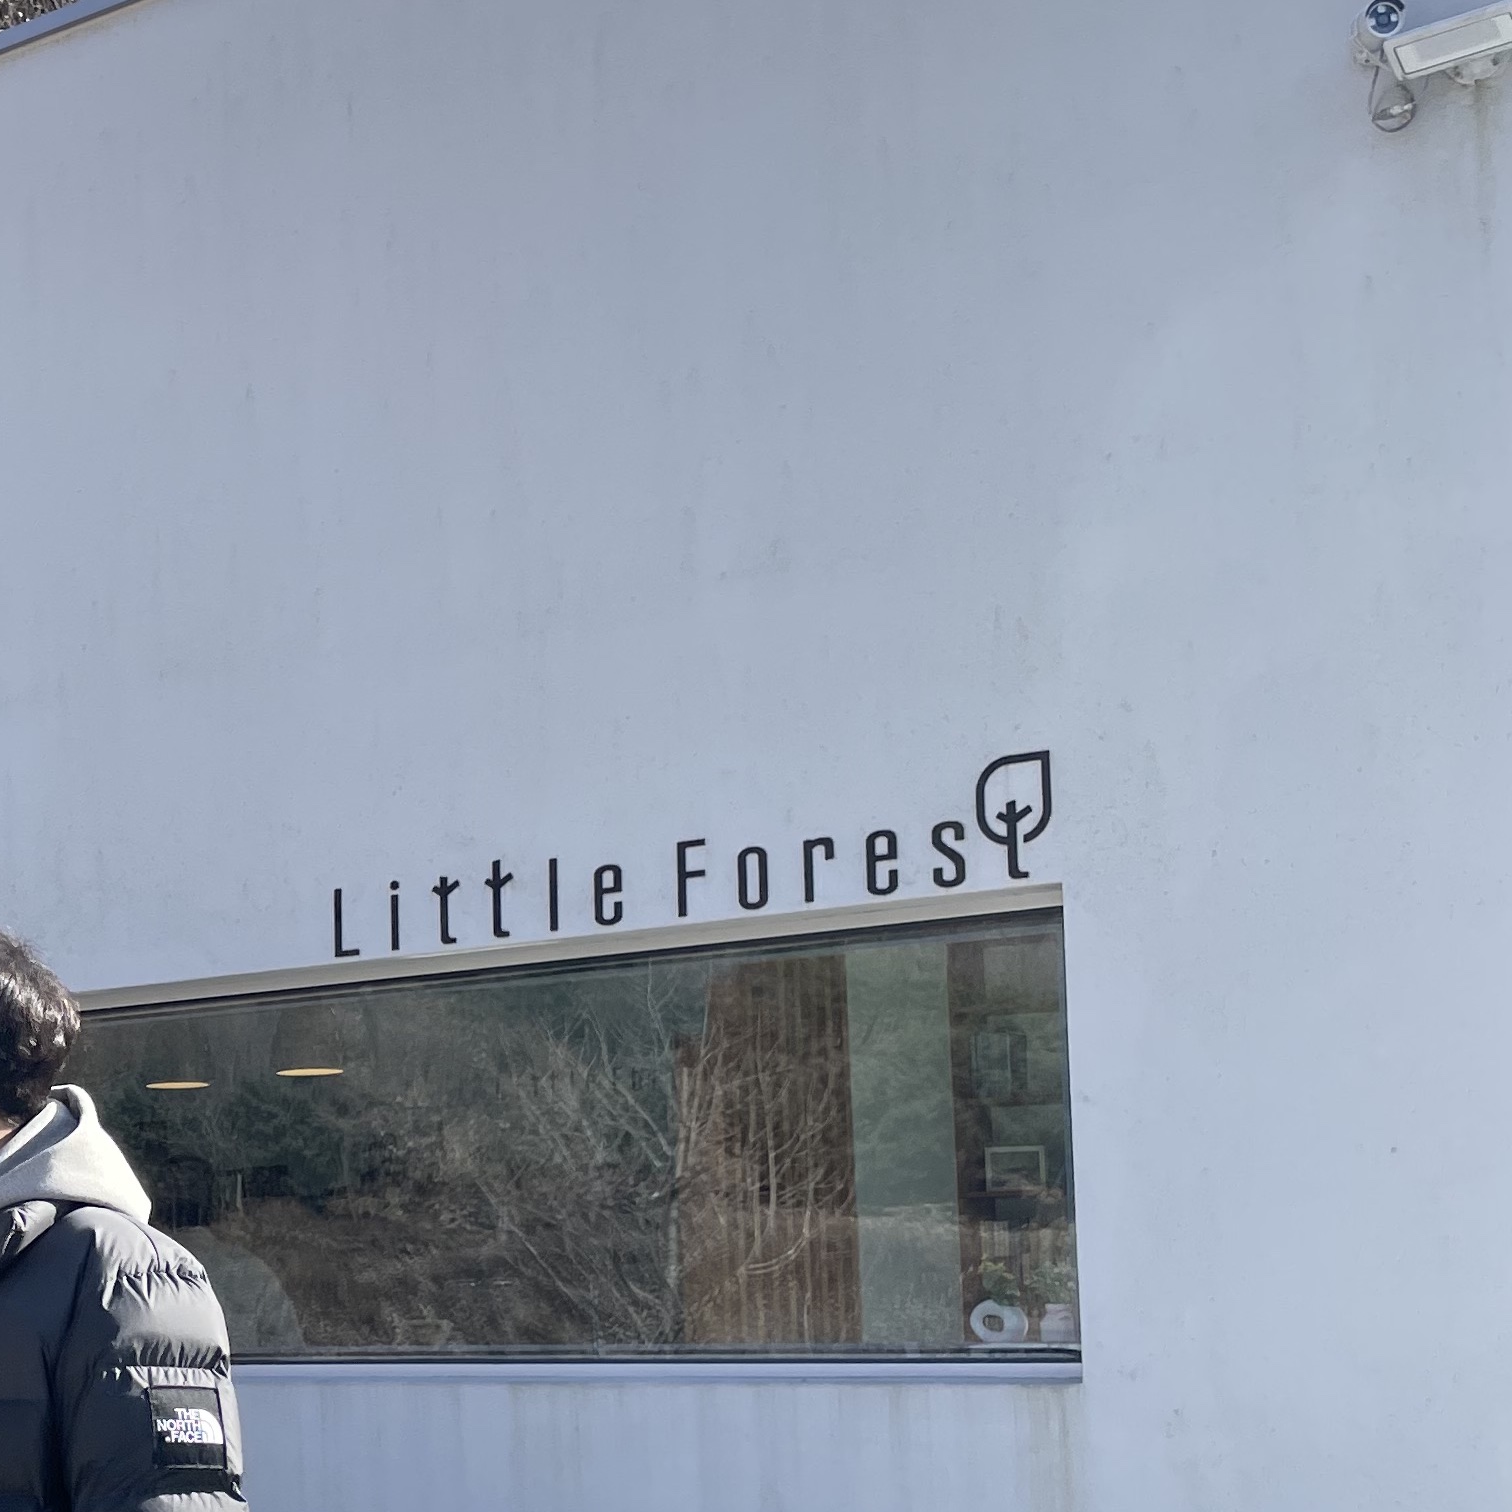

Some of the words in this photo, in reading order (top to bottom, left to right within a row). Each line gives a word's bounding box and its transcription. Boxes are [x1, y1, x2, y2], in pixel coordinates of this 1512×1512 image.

[333, 857, 623, 958] Little
[676, 749, 1052, 918] Forest
[173, 1407, 201, 1420] THE
[156, 1419, 201, 1432] NORTH
[170, 1430, 202, 1444] FACE
